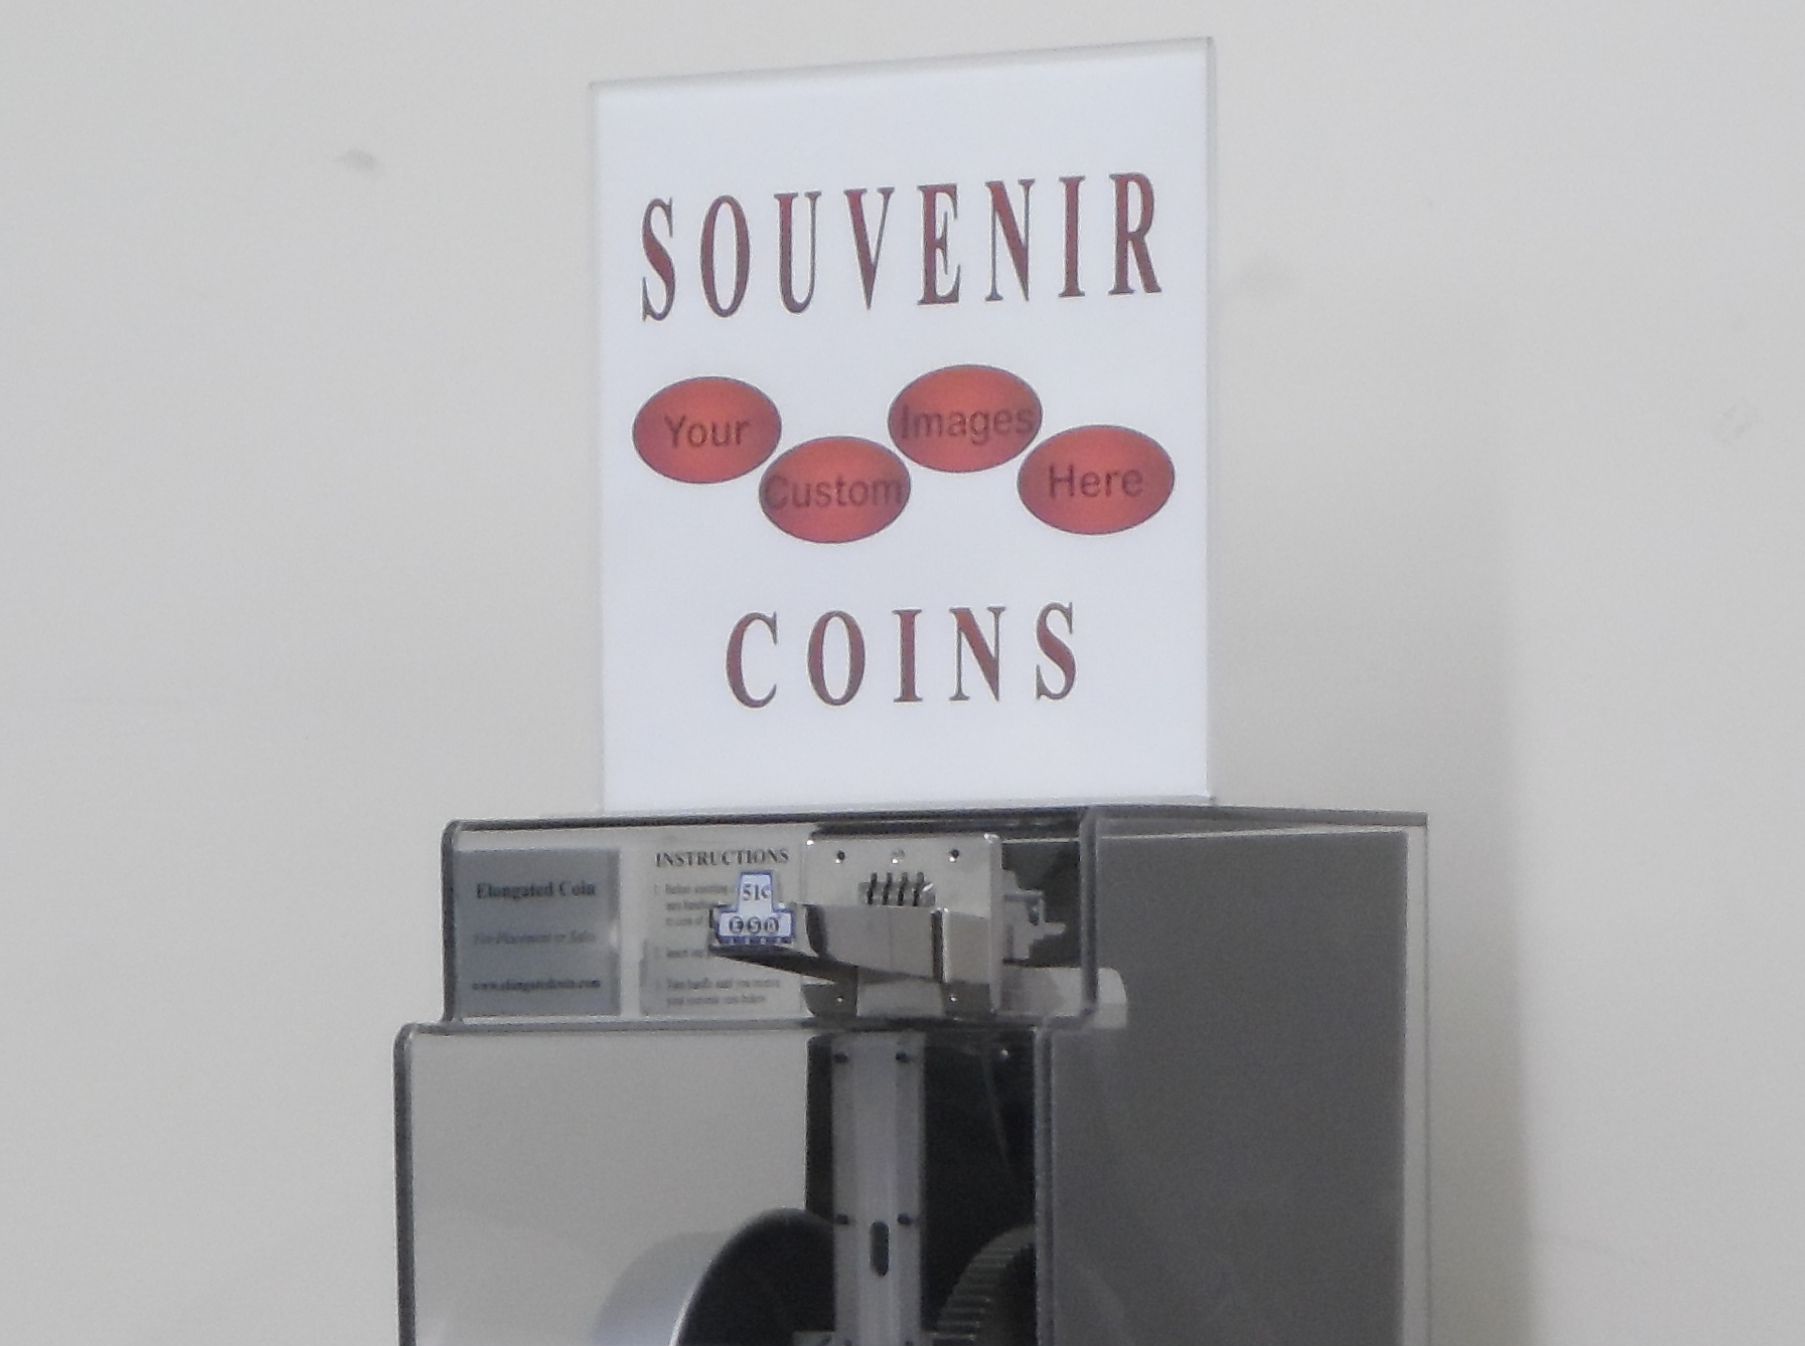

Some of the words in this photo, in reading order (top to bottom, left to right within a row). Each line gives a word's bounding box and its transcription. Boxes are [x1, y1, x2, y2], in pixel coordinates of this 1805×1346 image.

[640, 170, 1163, 323] SOUVENIR
[663, 414, 751, 450] Your
[762, 474, 905, 511] Custom
[900, 402, 1036, 445] Images
[1048, 463, 1147, 500] Here
[725, 602, 1078, 709] COINS
[476, 881, 553, 901] Elongated
[559, 879, 597, 898] Coin
[655, 848, 790, 868] INSTRUCTIONS
